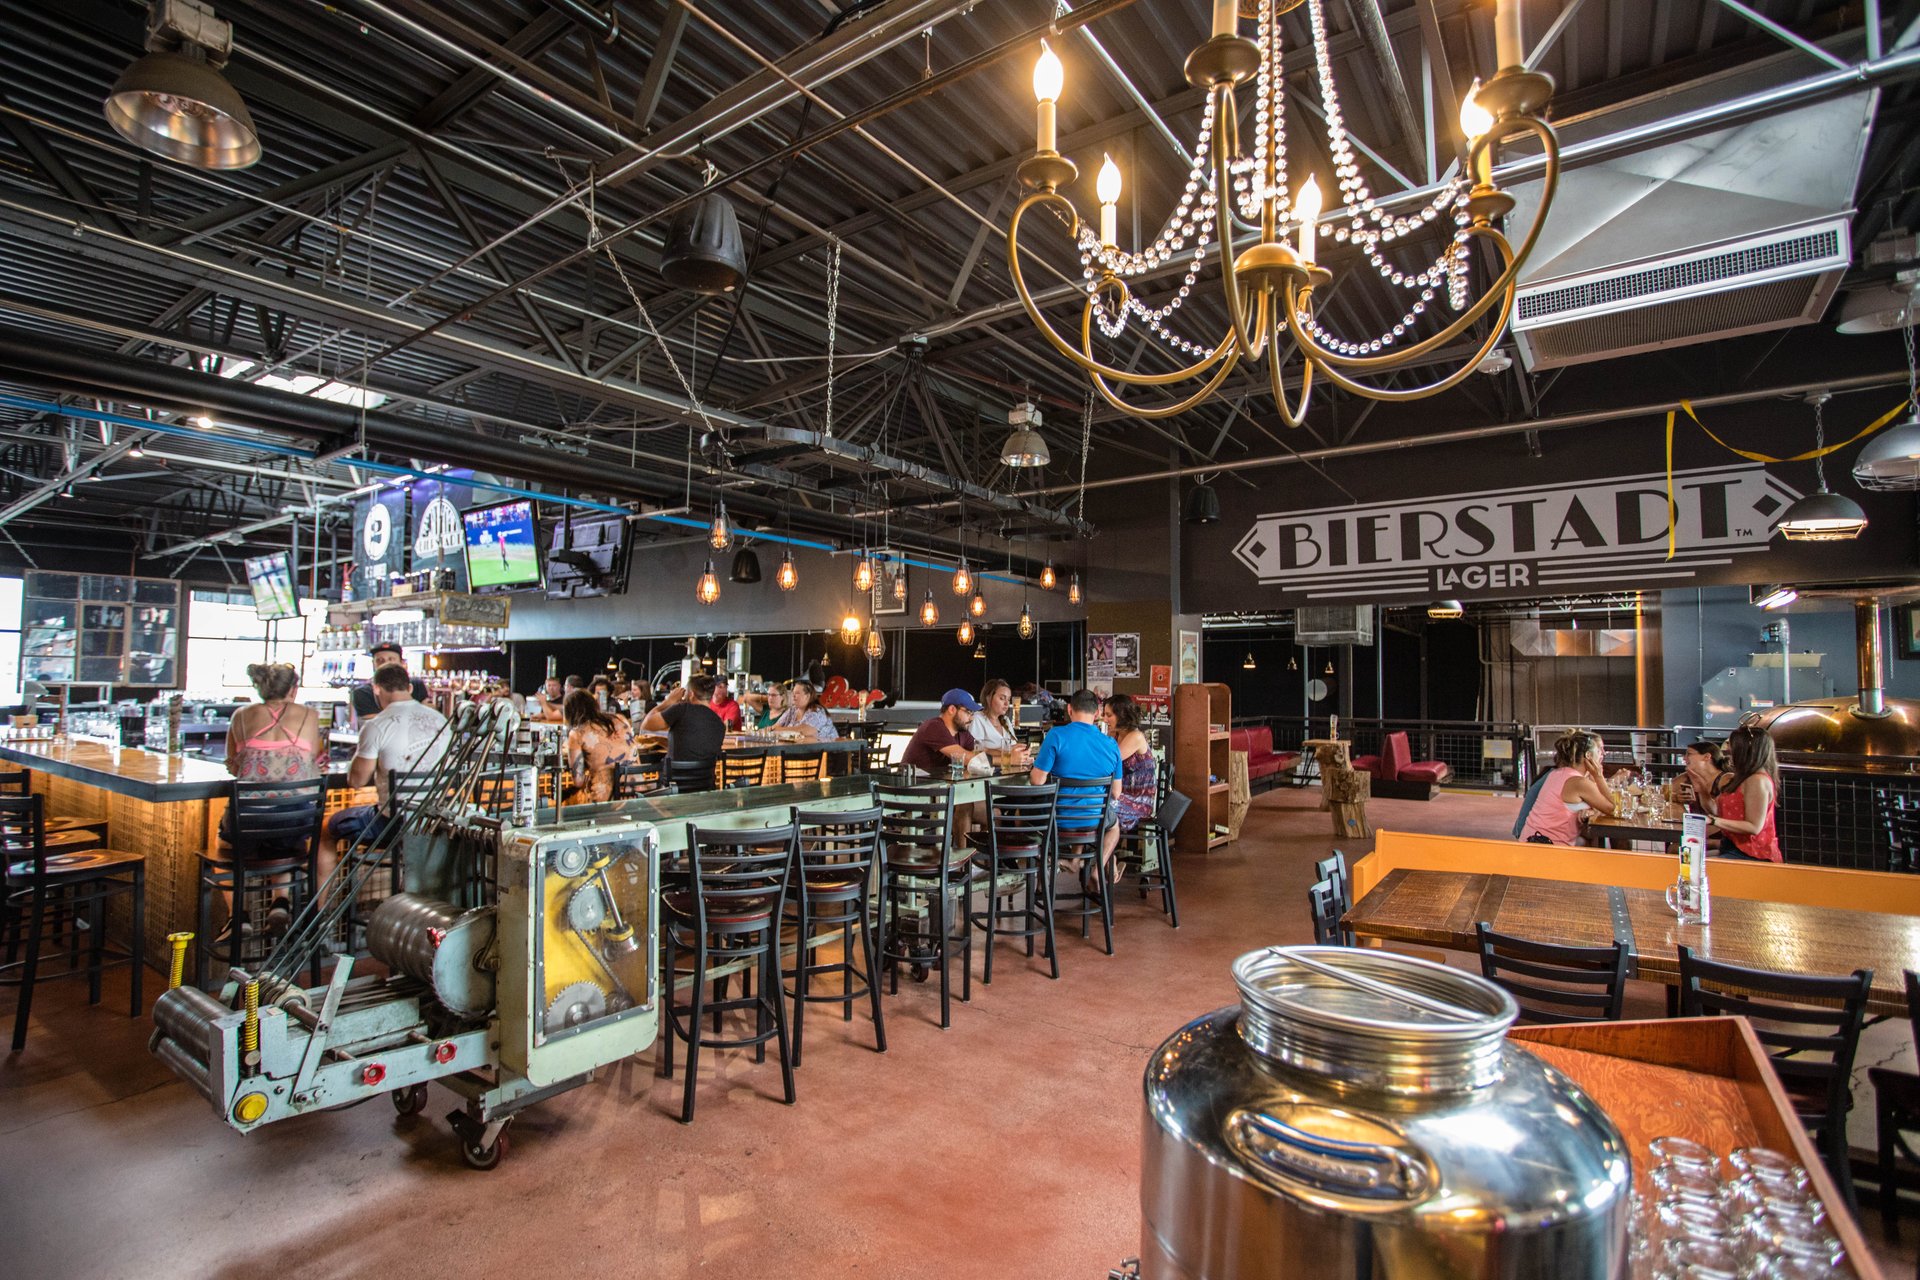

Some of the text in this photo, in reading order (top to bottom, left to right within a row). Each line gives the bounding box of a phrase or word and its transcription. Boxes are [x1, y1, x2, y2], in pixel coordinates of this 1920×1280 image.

[1279, 478, 1753, 571] BIERSTADT TM
[875, 564, 883, 608] BIERSTADT
[1436, 562, 1530, 591] LAGER
